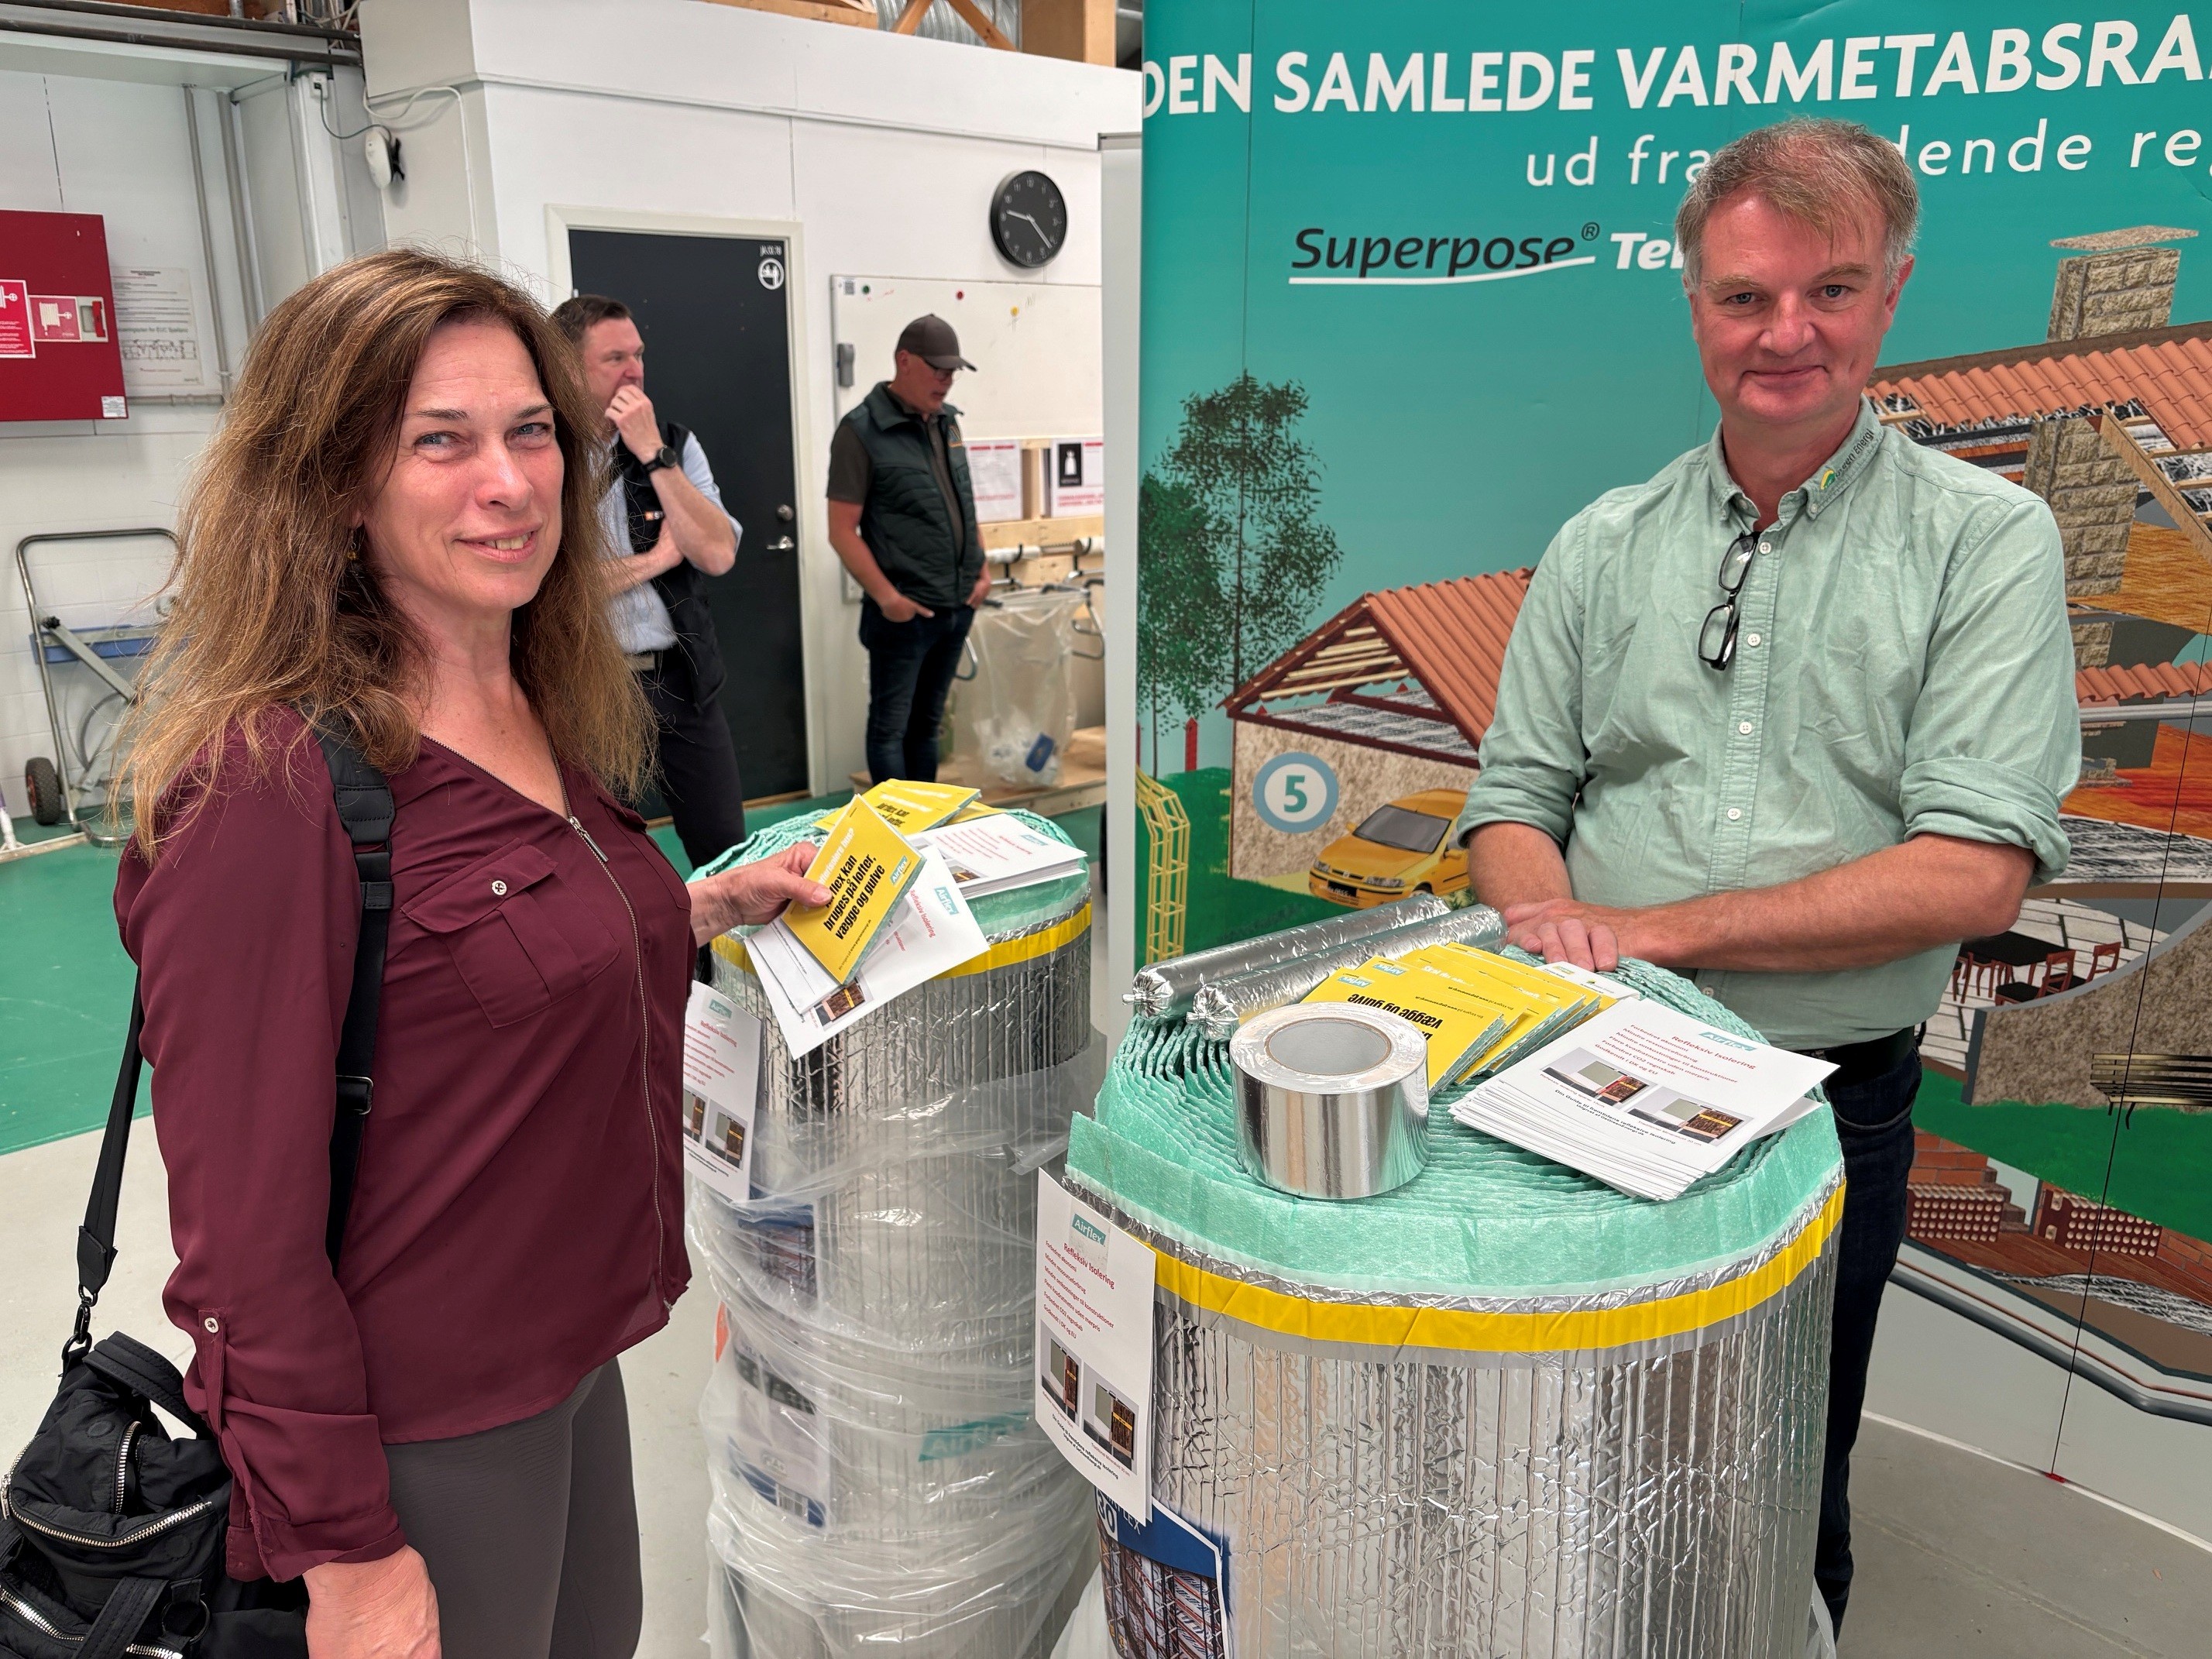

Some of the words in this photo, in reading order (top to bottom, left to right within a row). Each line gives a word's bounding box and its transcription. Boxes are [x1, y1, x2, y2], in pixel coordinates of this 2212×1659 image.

[1142, 52, 1252, 119] DEN
[1273, 50, 1595, 114] SAMLEDE
[1616, 13, 2212, 109] VARMETABSRA
[1526, 136, 1599, 187] ud
[1627, 134, 1712, 185] fra
[2129, 129, 2212, 177] re
[1283, 775, 1308, 813] 5
[824, 875, 847, 908] flex
[840, 854, 857, 877] kan
[891, 858, 907, 881] Airflex
[823, 894, 850, 931] bruges
[844, 878, 858, 899] på
[851, 854, 876, 884] lofter,
[835, 905, 860, 939] vægge
[856, 891, 869, 908] og
[864, 864, 884, 895] gulve
[936, 888, 956, 914] Airflex
[920, 912, 936, 938] Isolering
[1397, 1006, 1443, 1029] vægge
[1622, 1028, 1645, 1039] Mindre
[1630, 1024, 1660, 1039] Forbedret
[1595, 1043, 1624, 1060] Godkendt
[1601, 1039, 1632, 1056] Forbedret
[1646, 1061, 1675, 1074] regnskab
[1609, 1036, 1624, 1044] Flere
[1684, 1070, 1709, 1080] merpris
[1616, 1032, 1638, 1044] Mindre
[1689, 1064, 1737, 1083] konstruktioner
[1671, 1036, 1712, 1054] Refleksiv
[1714, 1053, 1756, 1069] Isolering
[1074, 1219, 1102, 1242] Airflex
[1045, 1240, 1061, 1259] Forbedret
[1063, 1242, 1087, 1267] Refleksiv
[1088, 1262, 1115, 1290] Isolering
[1044, 1265, 1056, 1280] Mindre
[1084, 1301, 1114, 1328] konstruktioner
[1070, 1330, 1077, 1338] EU
[1084, 1317, 1101, 1331] merpris
